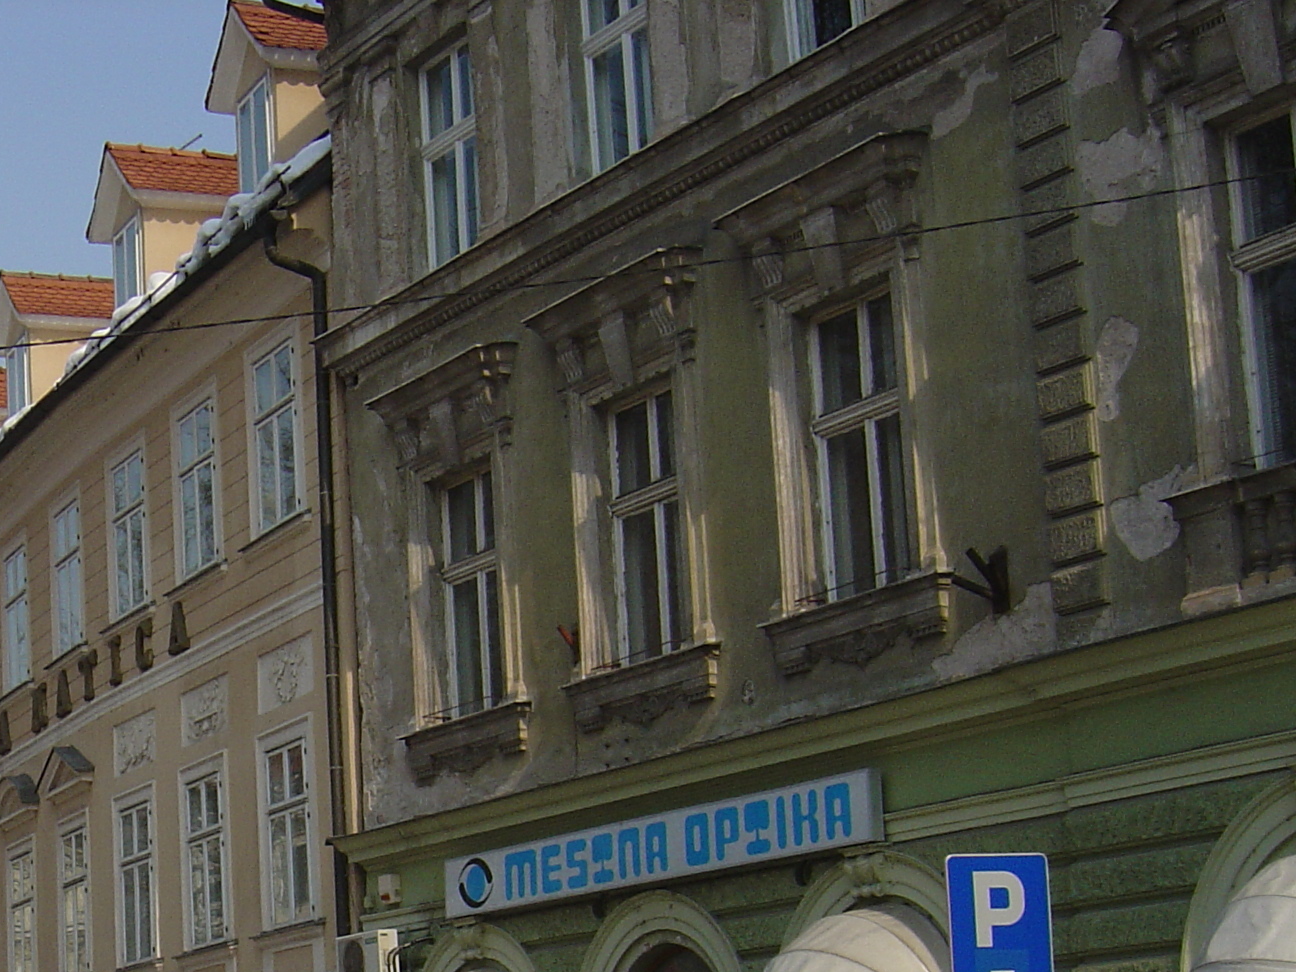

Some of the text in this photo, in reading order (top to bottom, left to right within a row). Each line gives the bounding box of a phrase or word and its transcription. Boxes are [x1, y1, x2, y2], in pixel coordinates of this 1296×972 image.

[31, 600, 191, 734] MATICA
[684, 782, 852, 867] OPTIKA
[972, 870, 1026, 948] P
